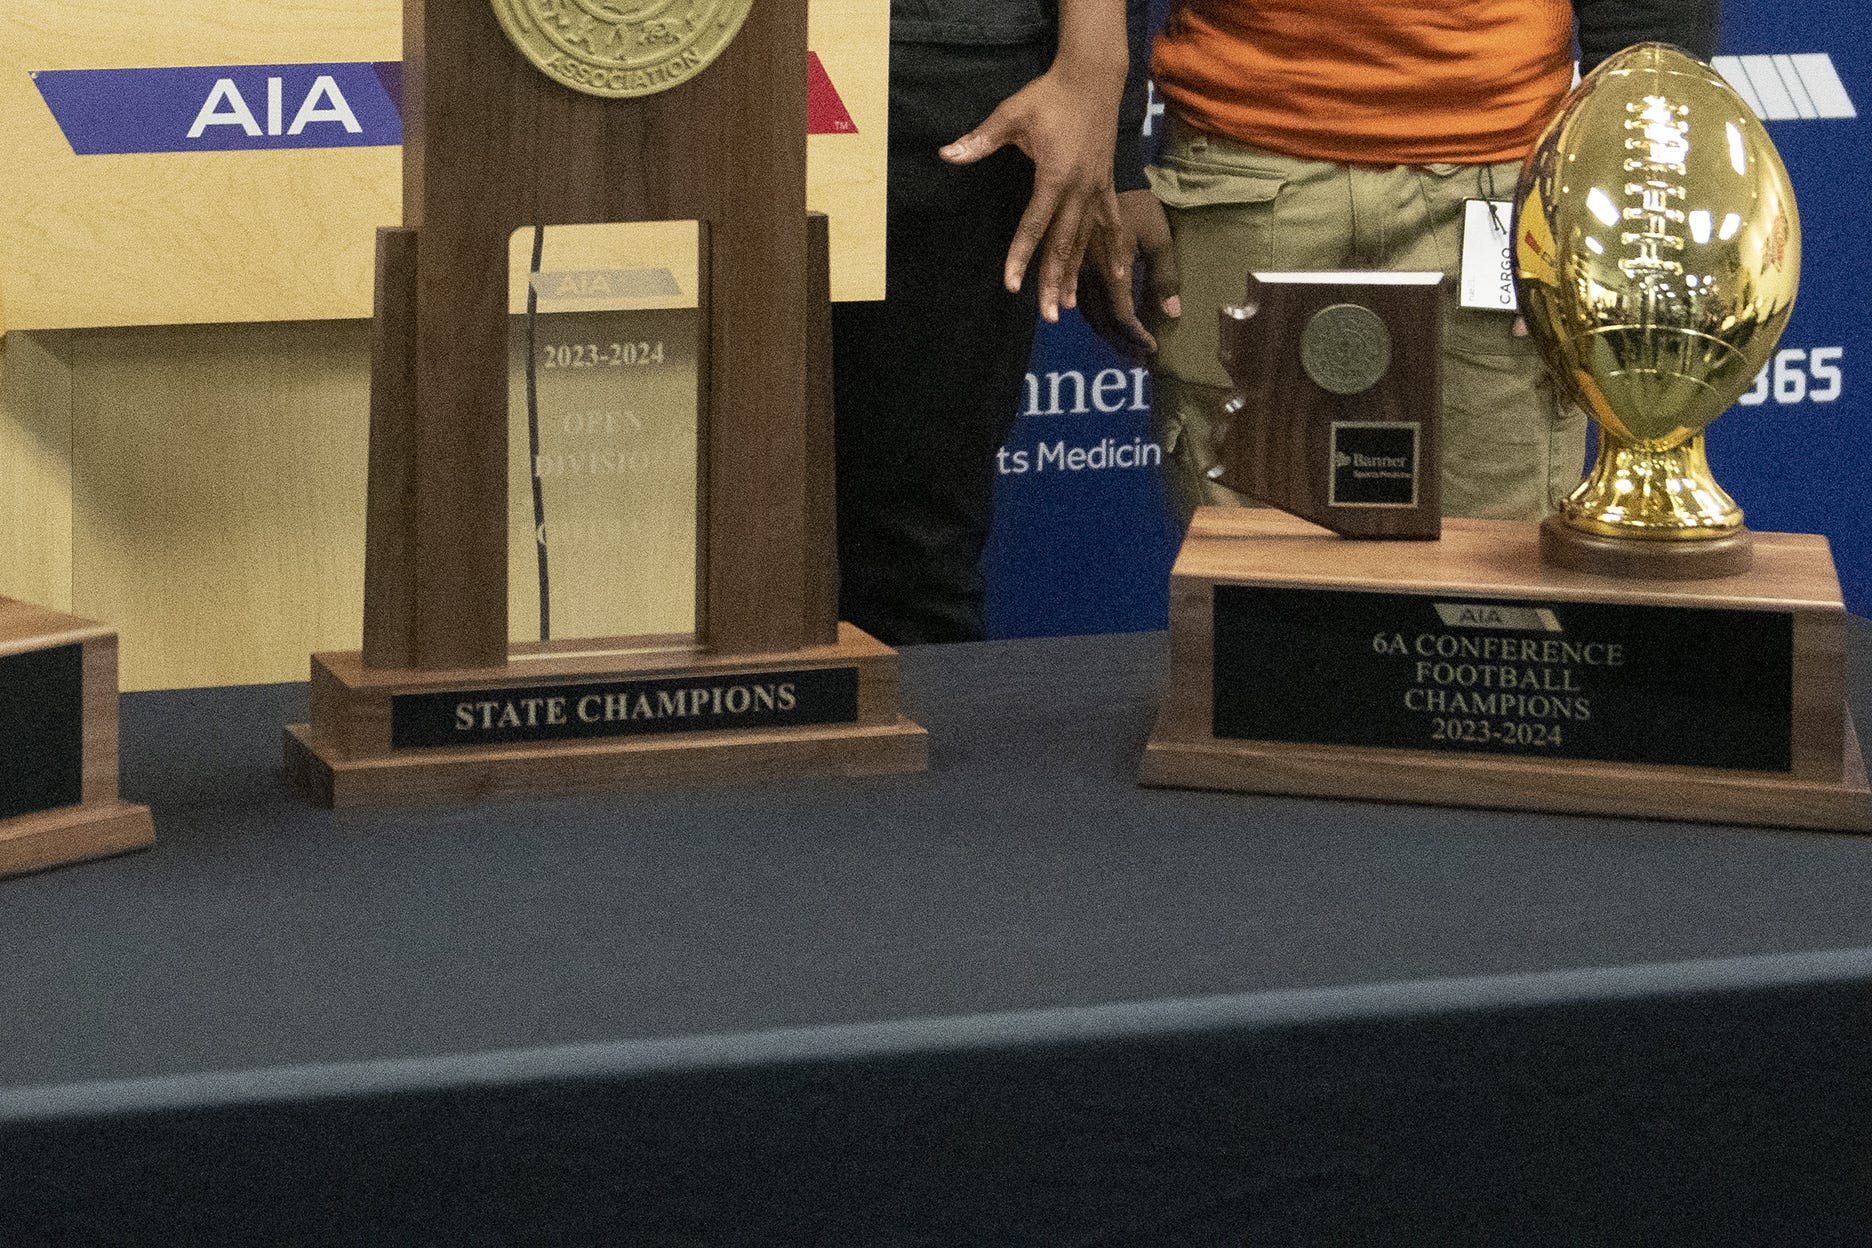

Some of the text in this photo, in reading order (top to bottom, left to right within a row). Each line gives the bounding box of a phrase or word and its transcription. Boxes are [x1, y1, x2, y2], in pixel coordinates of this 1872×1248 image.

[547, 49, 702, 91] ASSOCIATION
[186, 75, 364, 139] AIA
[1499, 247, 1512, 304] CARGO
[543, 341, 665, 369] 2023-2024
[537, 452, 651, 477] DIVISIO
[1459, 606, 1503, 625] AIA
[1372, 631, 1625, 666] 6A CONFERENCE
[1414, 661, 1580, 691] FOOTBALL
[454, 682, 797, 731] STATE CHAMPIONS
[1403, 688, 1592, 721] CHAMPIONS
[1431, 717, 1563, 747] 2023-2024
